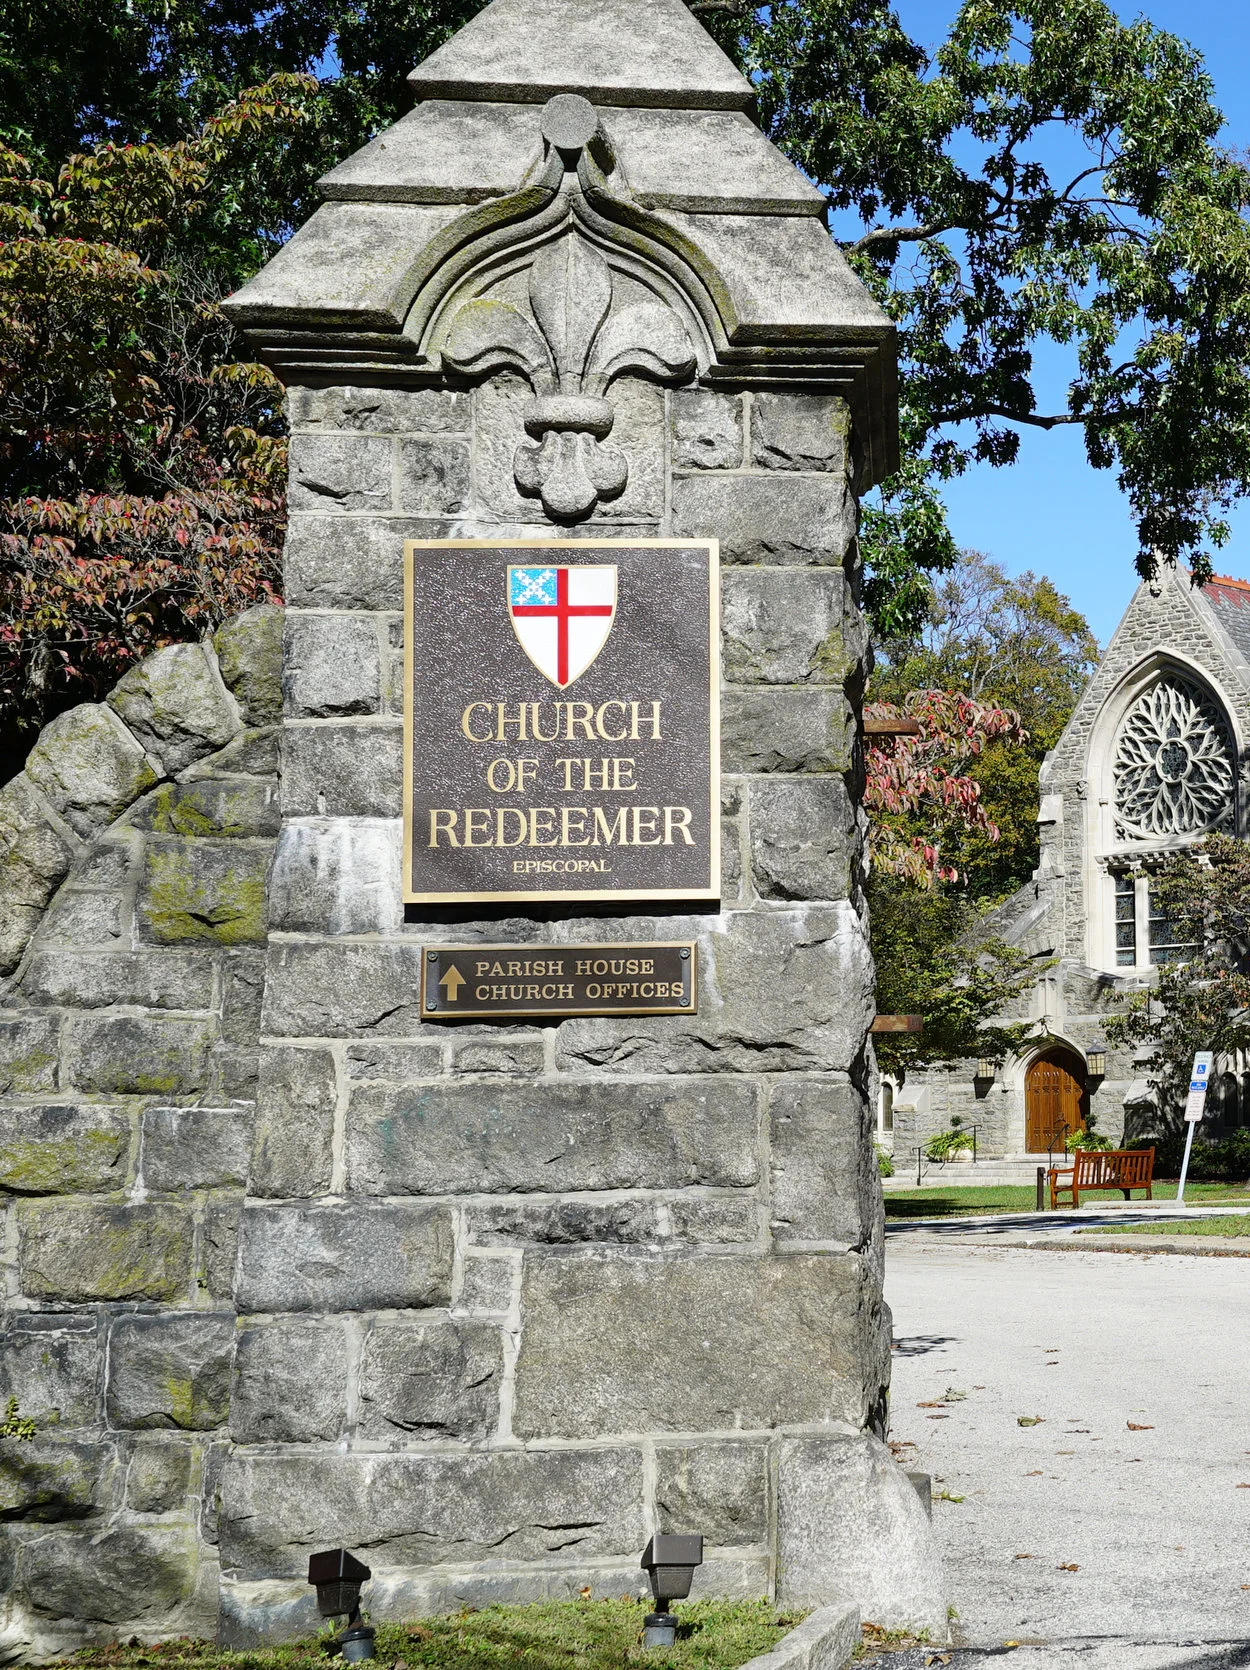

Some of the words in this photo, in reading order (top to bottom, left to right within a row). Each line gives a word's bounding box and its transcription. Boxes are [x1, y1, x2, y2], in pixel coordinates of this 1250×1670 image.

[462, 701, 663, 742] CHURCH
[486, 758, 538, 793] OF
[554, 758, 638, 791] THE
[428, 806, 696, 848] REDEEMER
[512, 859, 612, 874] EPISCOPAL
[475, 961, 564, 976] PARISH
[575, 959, 654, 975] HOUSE
[475, 984, 574, 1000] CHURCH
[585, 982, 684, 998] OFFICES
